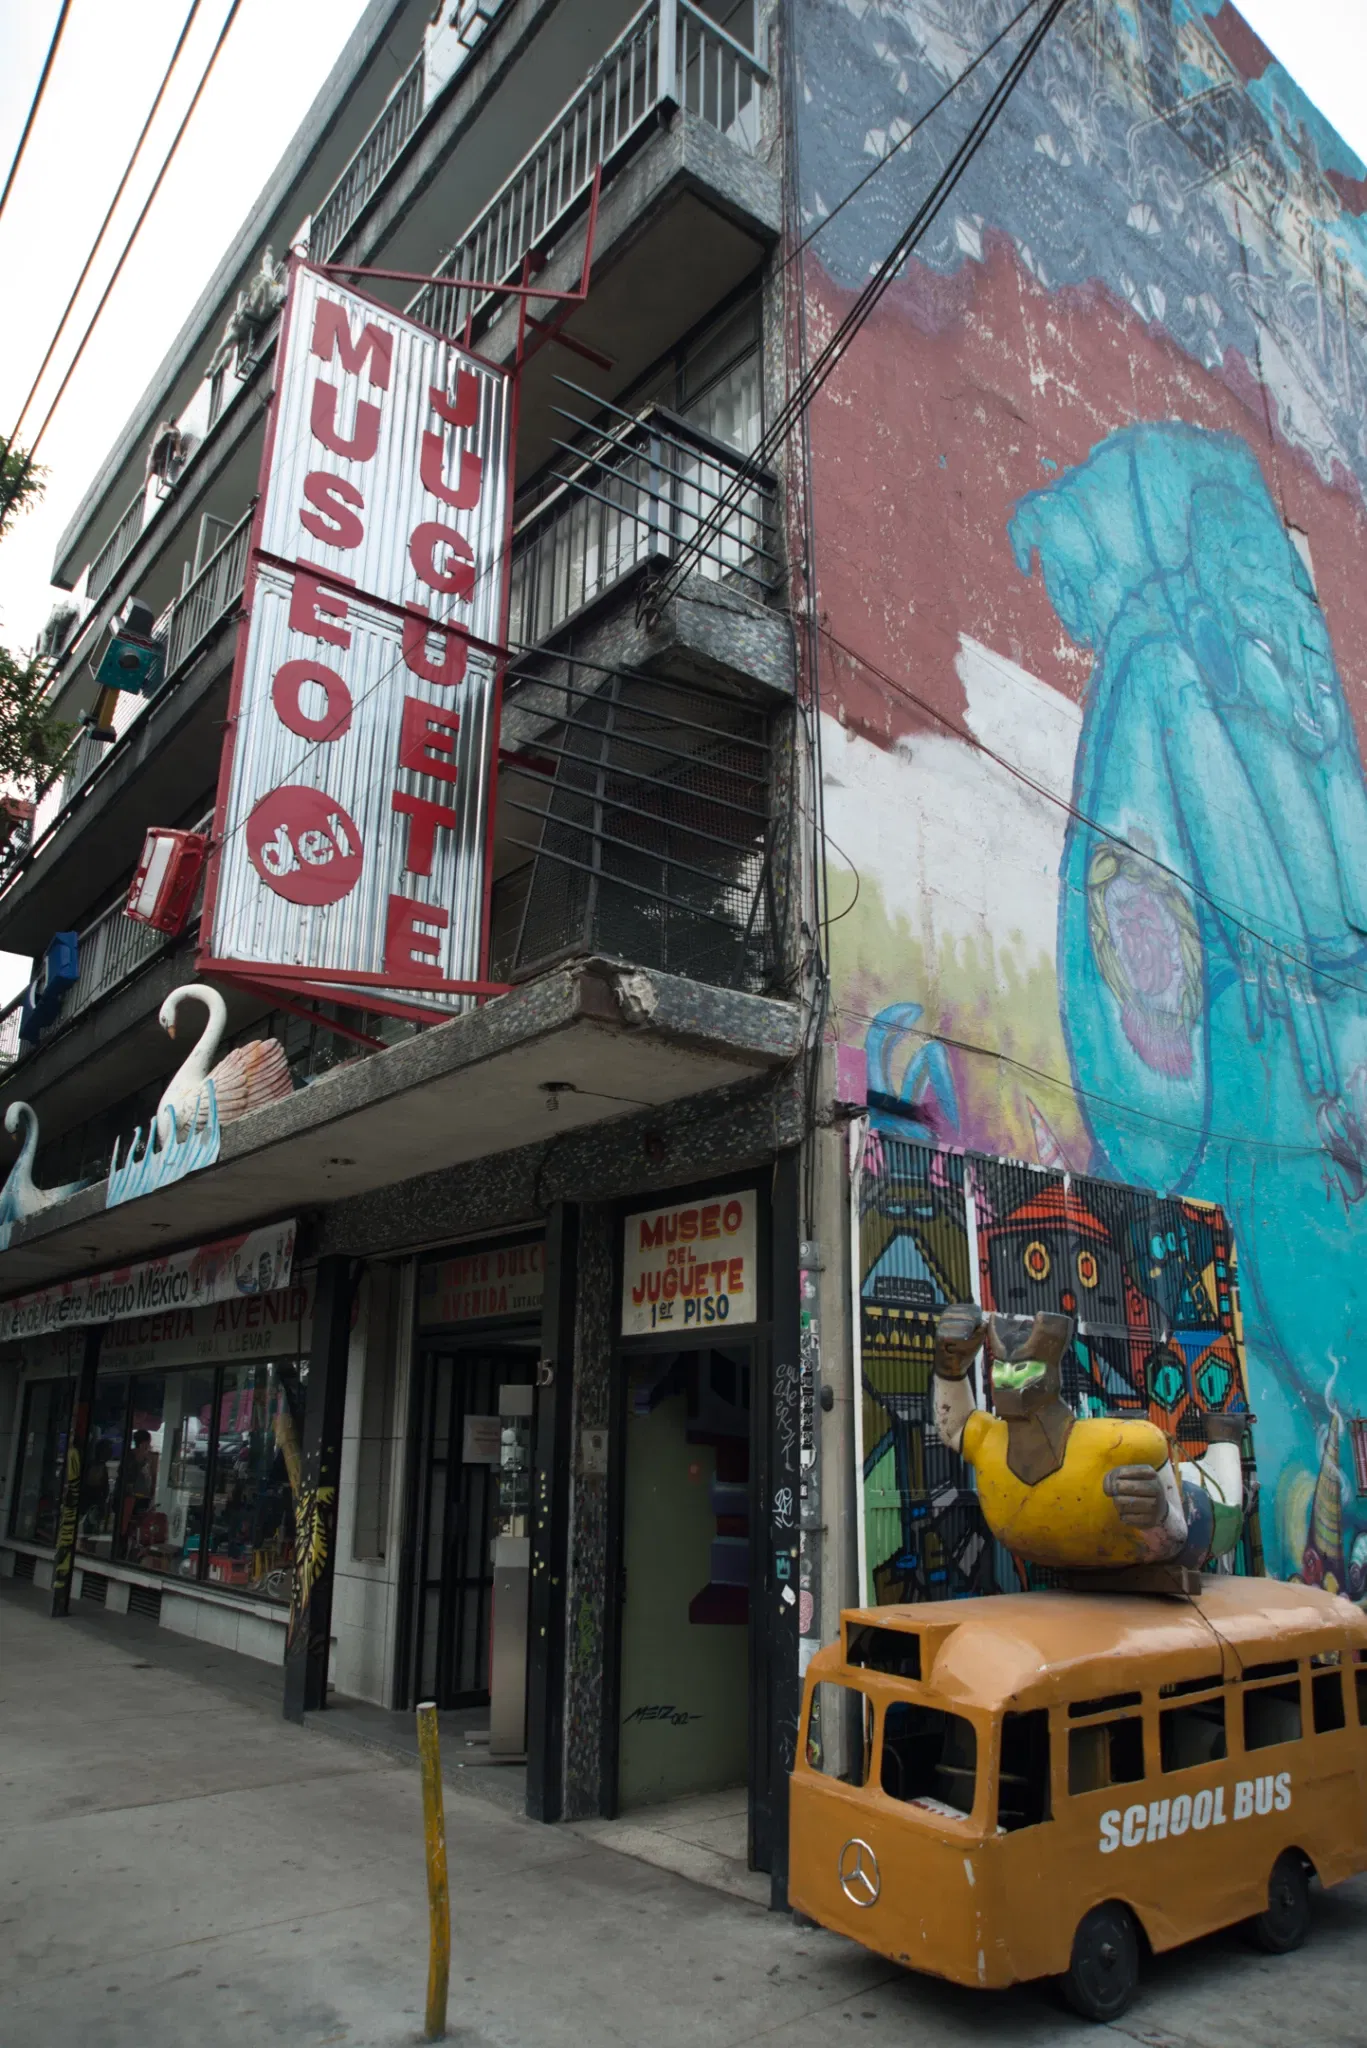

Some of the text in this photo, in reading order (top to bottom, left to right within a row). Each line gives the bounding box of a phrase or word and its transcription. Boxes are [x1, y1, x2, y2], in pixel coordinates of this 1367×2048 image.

[269, 295, 393, 743] MUSEO
[384, 367, 482, 979] JUGUETE
[260, 813, 355, 877] del
[639, 1200, 743, 1253] MUSEO
[496, 1243, 547, 1279] DULC
[632, 1257, 744, 1308] JUGUETE
[667, 1246, 697, 1266] DEL
[84, 1282, 134, 1321] Antiguo
[138, 1265, 188, 1309] México
[213, 1286, 316, 1333] AVENID
[651, 1300, 674, 1328] 1er
[684, 1294, 730, 1326] PISO
[1099, 1772, 1292, 1854] SCHOOL BUS
